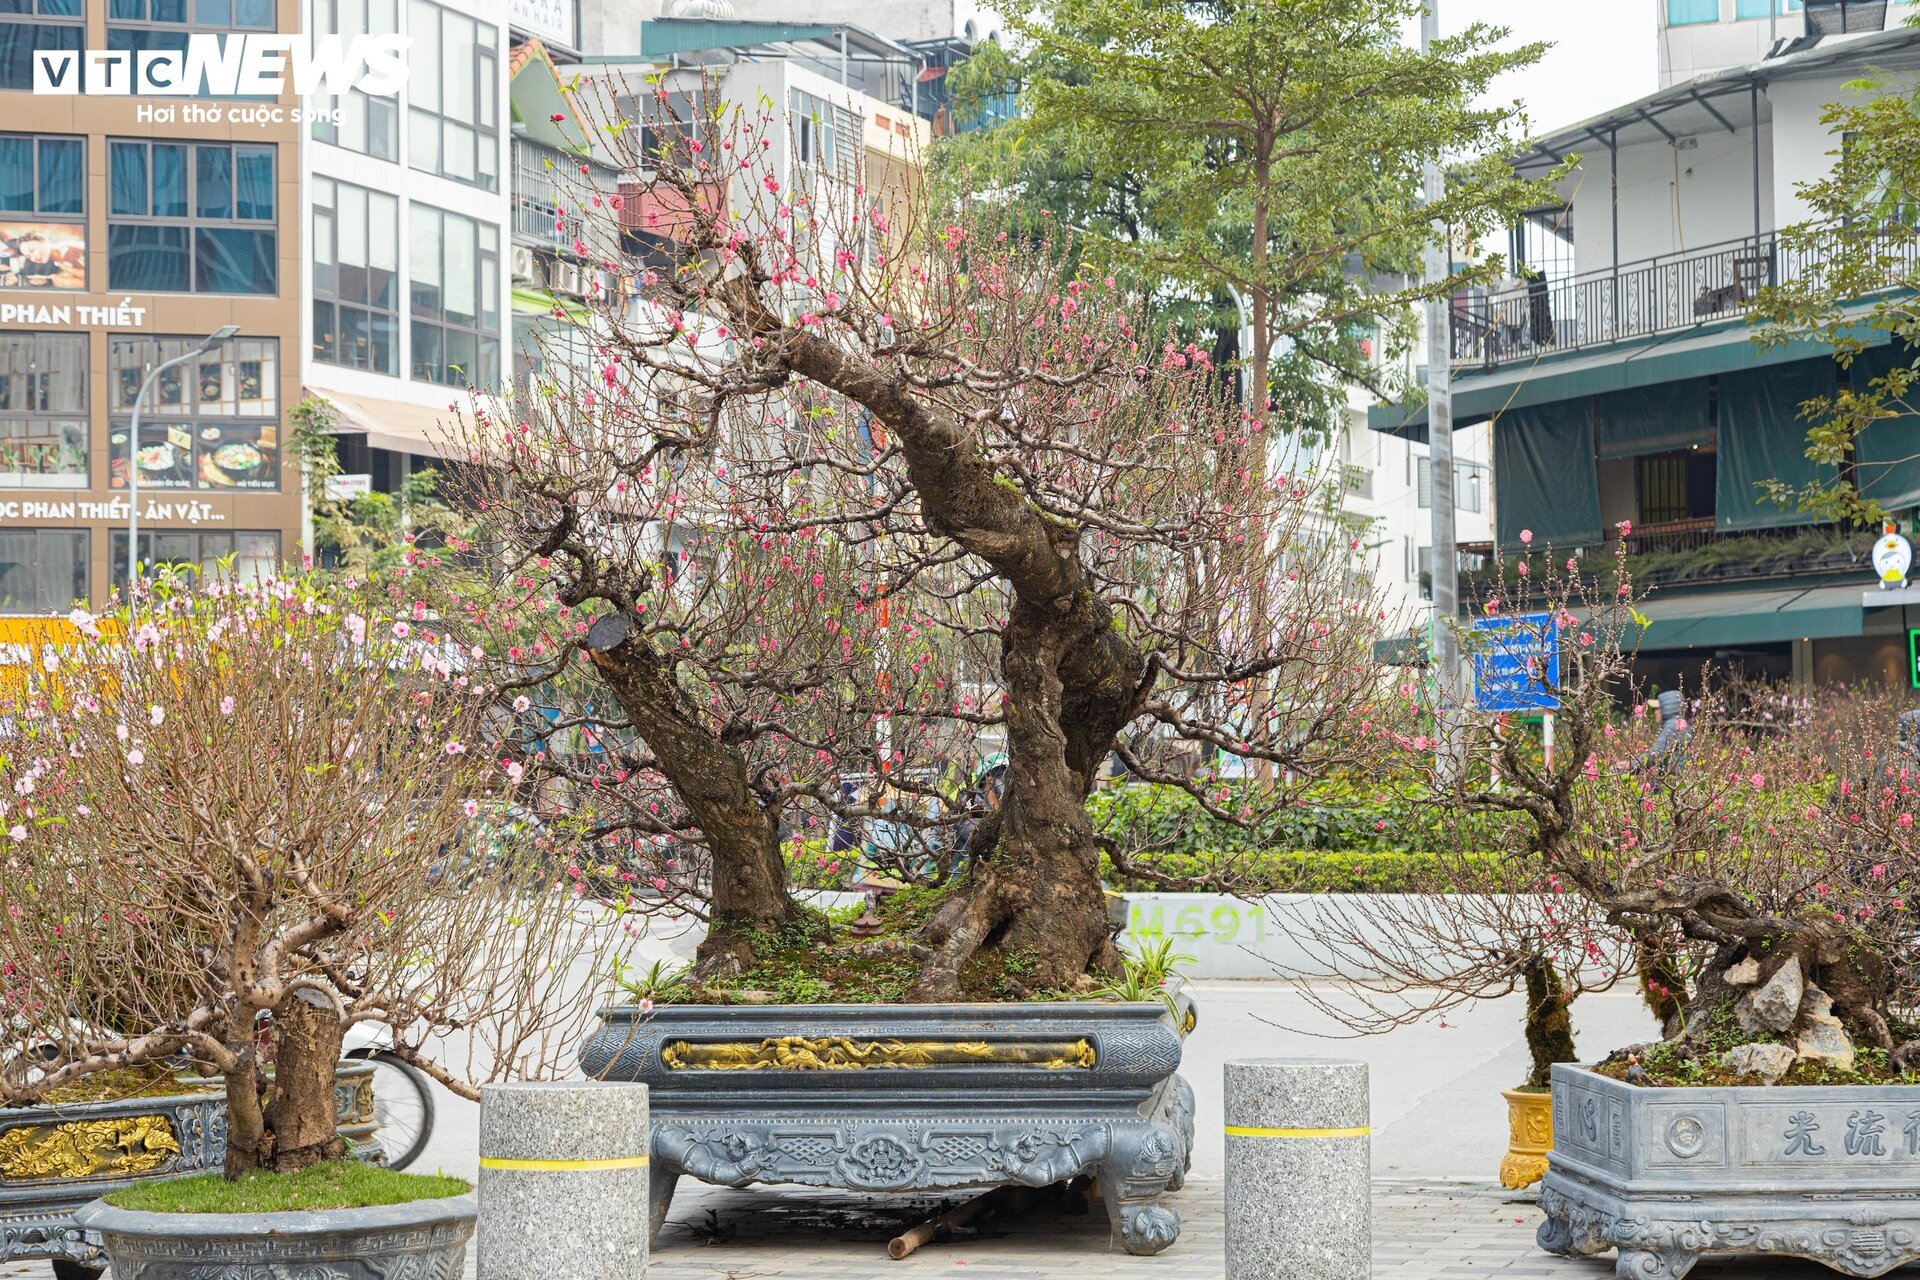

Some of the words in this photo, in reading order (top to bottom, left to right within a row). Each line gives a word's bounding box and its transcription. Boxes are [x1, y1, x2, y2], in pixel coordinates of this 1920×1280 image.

[1, 303, 71, 325] PHAN
[76, 296, 146, 327] THIẾT
[0, 501, 19, 522] C
[22, 502, 75, 519] PHAN
[78, 496, 130, 520] THIẾT
[145, 499, 172, 520] ĂN
